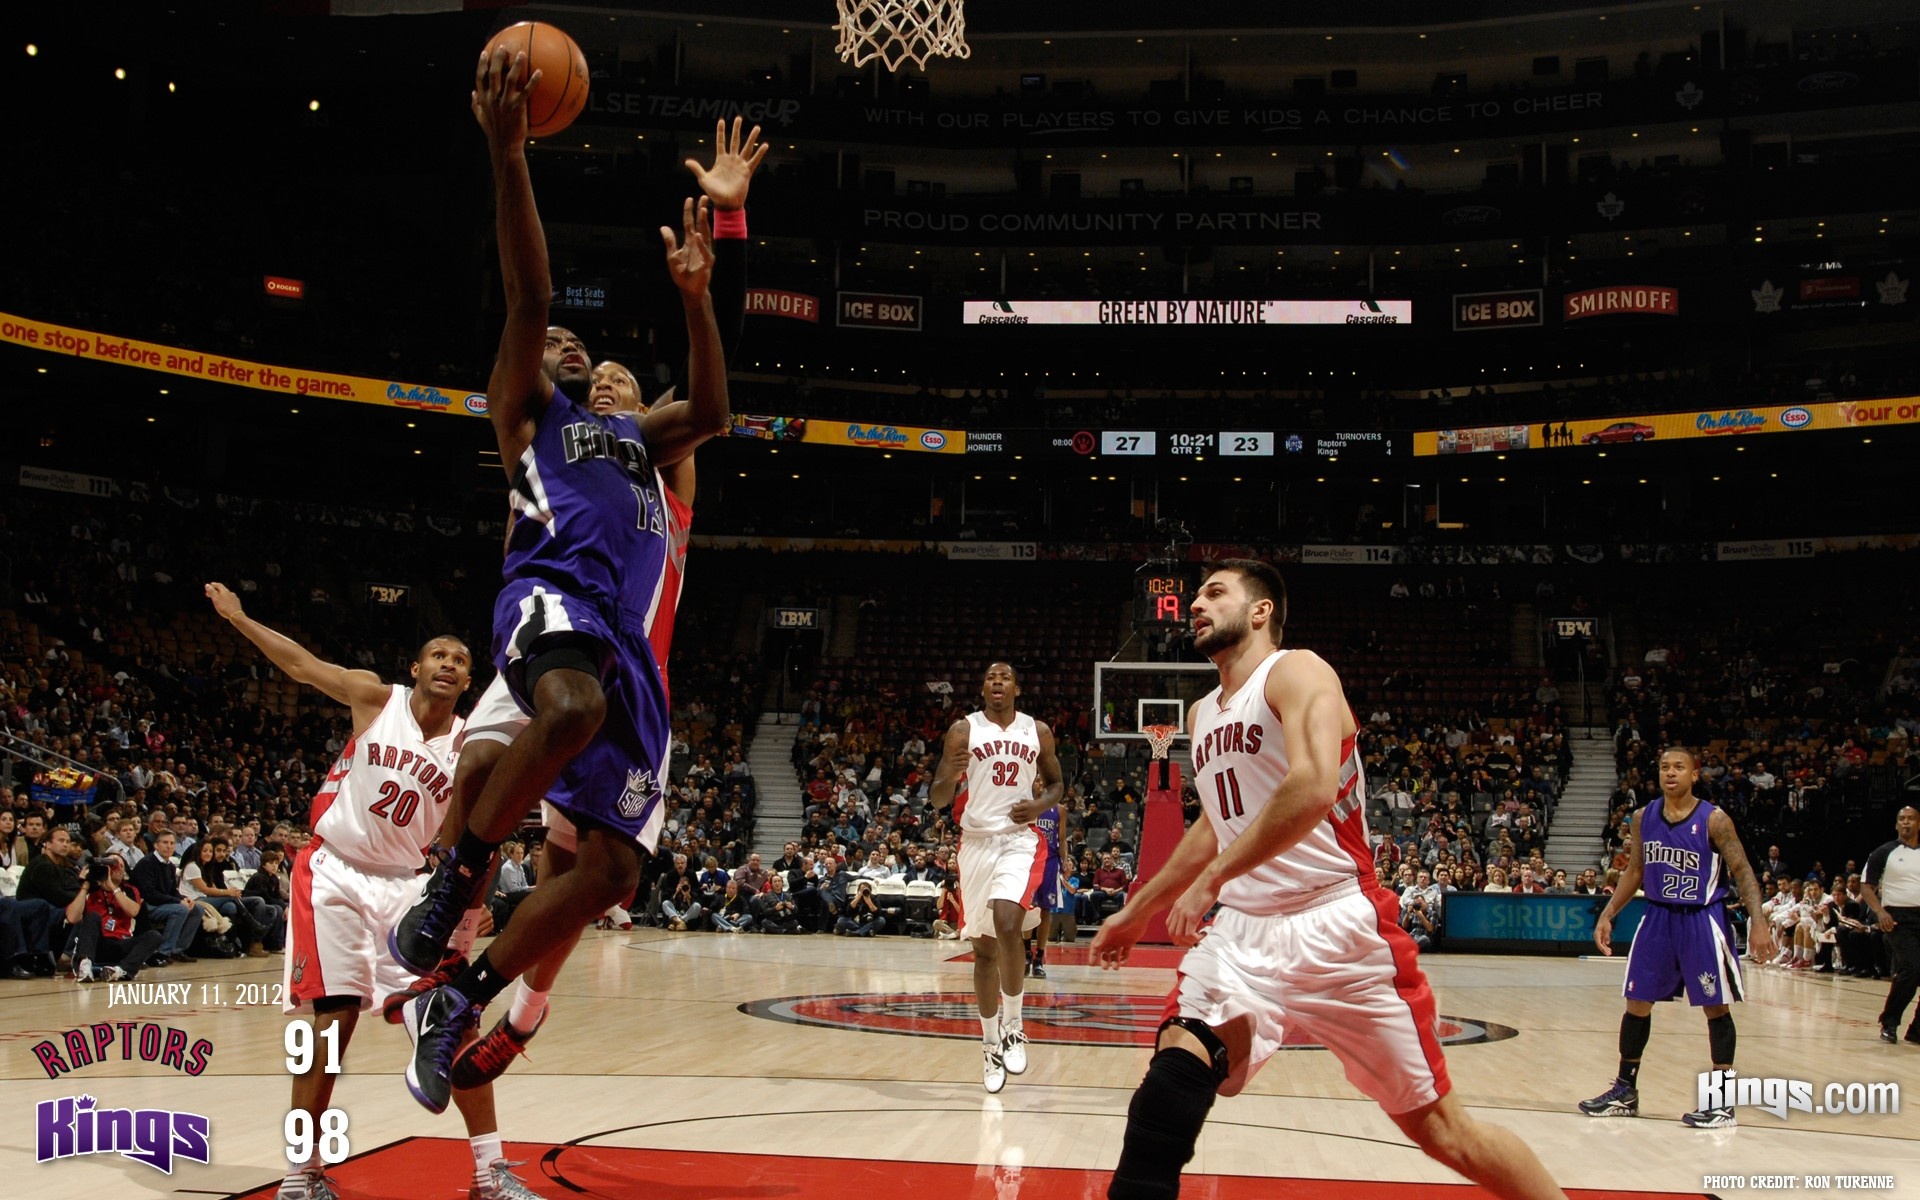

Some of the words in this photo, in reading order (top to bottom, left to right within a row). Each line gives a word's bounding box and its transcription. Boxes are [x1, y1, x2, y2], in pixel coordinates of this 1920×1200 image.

[589, 91, 640, 114] LSE
[864, 107, 925, 127] WITH
[936, 112, 990, 129] OUR
[1002, 110, 1116, 128] PLAYERS
[1126, 109, 1161, 126] TO
[1172, 109, 1232, 126] GIVE
[1243, 109, 1302, 125] KIDS
[1313, 108, 1332, 125] A
[1343, 105, 1453, 125] CHANCE
[1464, 101, 1501, 120] TO
[1513, 91, 1604, 115] CHEER
[863, 208, 970, 232] PROUD
[979, 211, 1165, 233] COMMUNITY
[1175, 211, 1322, 231] PARTNER
[566, 286, 582, 298] Best
[584, 287, 605, 299] Seats
[746, 293, 814, 317] IRNOFF
[1461, 302, 1492, 322] ICE
[1496, 300, 1535, 319] BOX
[1569, 290, 1672, 316] SMIRNOFF
[845, 302, 873, 321] ICE
[878, 303, 915, 323] BOX
[978, 314, 1029, 325] Cascades
[1098, 301, 1158, 324] GREEN
[1167, 301, 1189, 324] BY
[1345, 314, 1398, 325] Cascades
[2, 321, 39, 344] one
[43, 330, 90, 357] stop
[96, 337, 161, 366] before
[166, 354, 204, 375] and
[207, 360, 255, 384] after
[259, 367, 291, 389] the
[295, 376, 356, 398] game.
[387, 383, 405, 399] On
[469, 399, 488, 409] Esso
[1697, 413, 1716, 430] On
[1735, 409, 1767, 427] Run
[1785, 413, 1806, 422] Esso
[1841, 404, 1892, 423] Your
[848, 424, 866, 440] On
[884, 426, 909, 442] Run
[924, 434, 942, 445] Esso
[967, 432, 1002, 441] THUNDER
[1169, 433, 1214, 447] 10:21
[1335, 432, 1382, 441] TURNOVERS
[967, 443, 1002, 452] HORNETS
[1052, 437, 1073, 447] 08:00
[1115, 436, 1141, 451] 27
[1234, 437, 1259, 452] 23
[1317, 439, 1347, 449] Raptors
[1171, 446, 1190, 456] QTR
[1192, 446, 1202, 456] 2
[1317, 447, 1339, 457] Kings
[1386, 448, 1392, 456] 4
[22, 470, 49, 482] Bruce
[89, 478, 110, 494] 111
[952, 545, 977, 554] Bruce
[977, 544, 1001, 554] Power
[1011, 545, 1035, 557] 113
[1304, 549, 1329, 558] Bruce
[1329, 548, 1355, 558] Power
[1366, 549, 1390, 561] 114
[1722, 545, 1749, 554] Bruce
[1787, 541, 1813, 555] 115
[1148, 578, 1184, 593] 10:21
[1157, 595, 1179, 622] 19
[780, 611, 813, 627] IBM
[1557, 621, 1592, 637] IBM
[972, 740, 1037, 765] RAPTORS
[1192, 721, 1264, 778] APTORS
[367, 742, 453, 804] RAPTORS
[992, 761, 1019, 787] 32
[1214, 767, 1245, 821] 11
[368, 780, 420, 827] 20
[1643, 840, 1700, 873] Kings
[1662, 873, 1699, 900] 22
[1491, 903, 1585, 930] SIRIUS
[1493, 928, 1561, 941] SATELLITE
